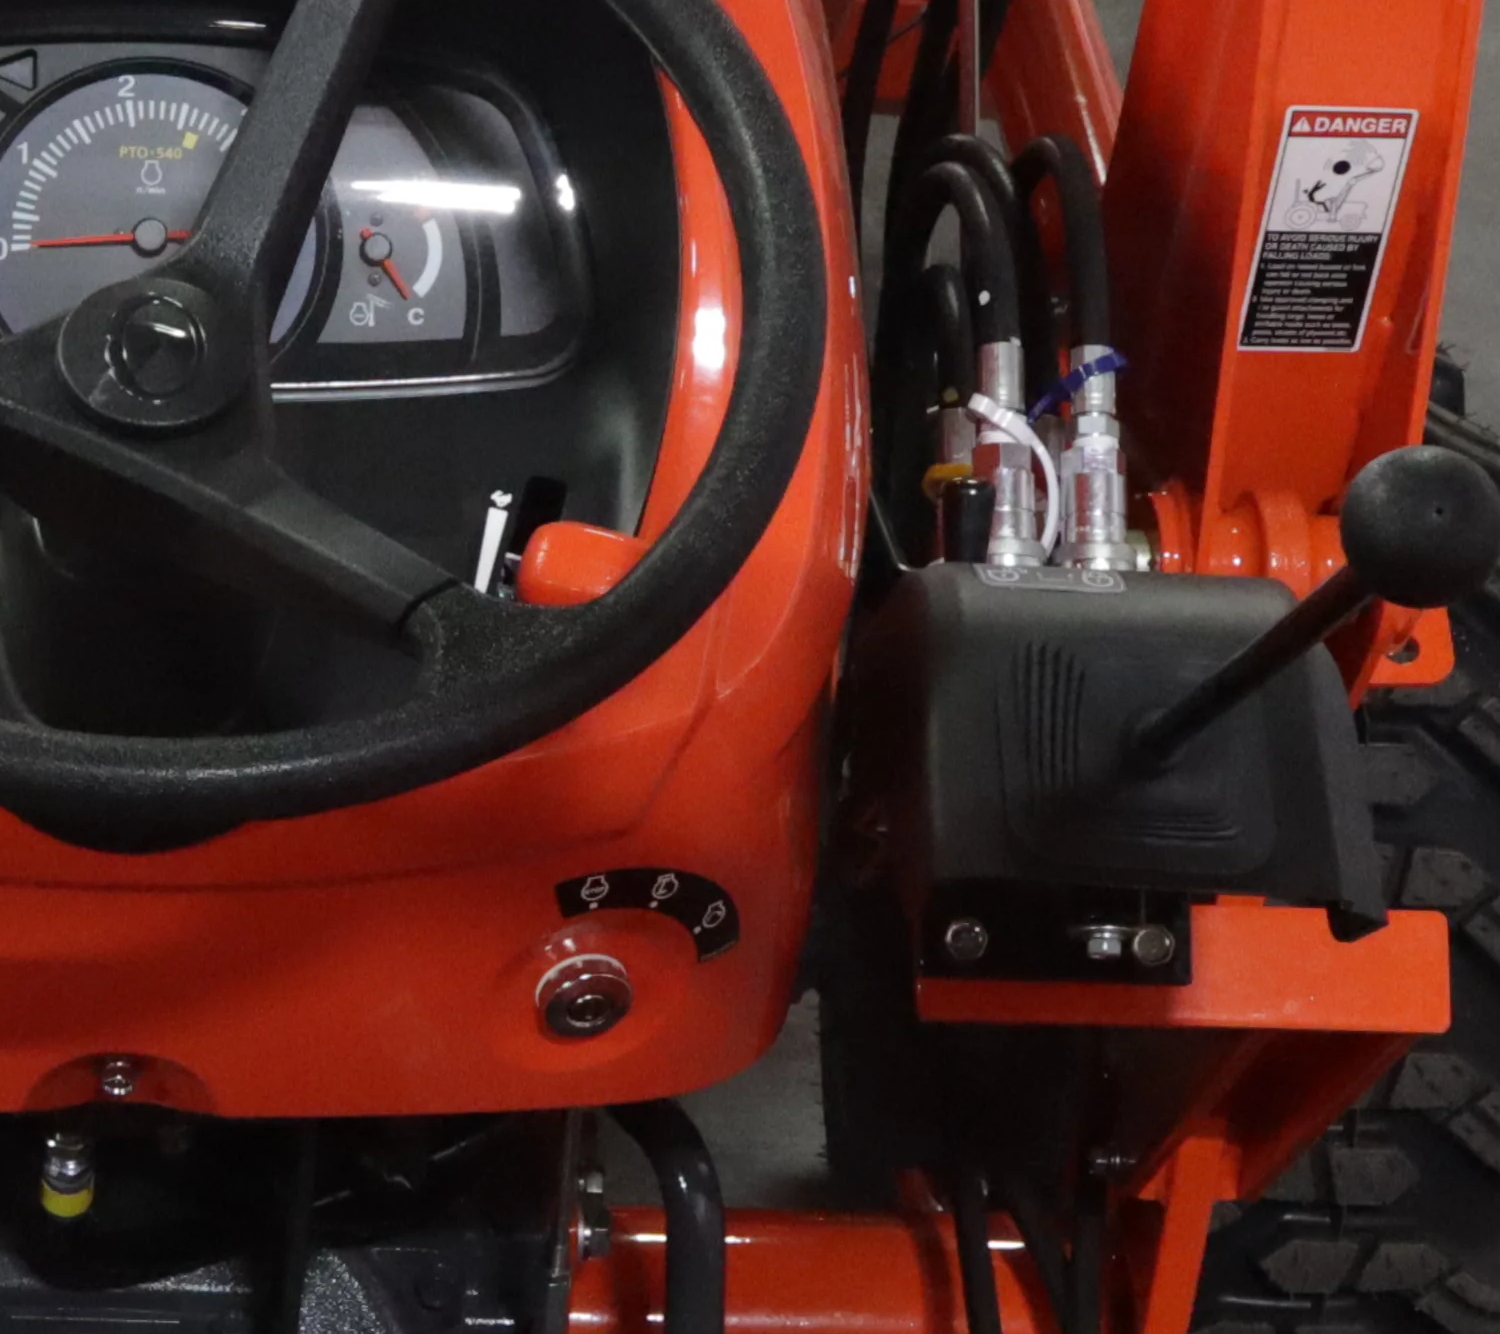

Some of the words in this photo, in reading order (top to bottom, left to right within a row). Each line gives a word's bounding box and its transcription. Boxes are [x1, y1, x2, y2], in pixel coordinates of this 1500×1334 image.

[117, 75, 136, 97] 2
[1314, 117, 1408, 134] DANGER
[17, 142, 29, 164] 1
[407, 307, 425, 326] C
